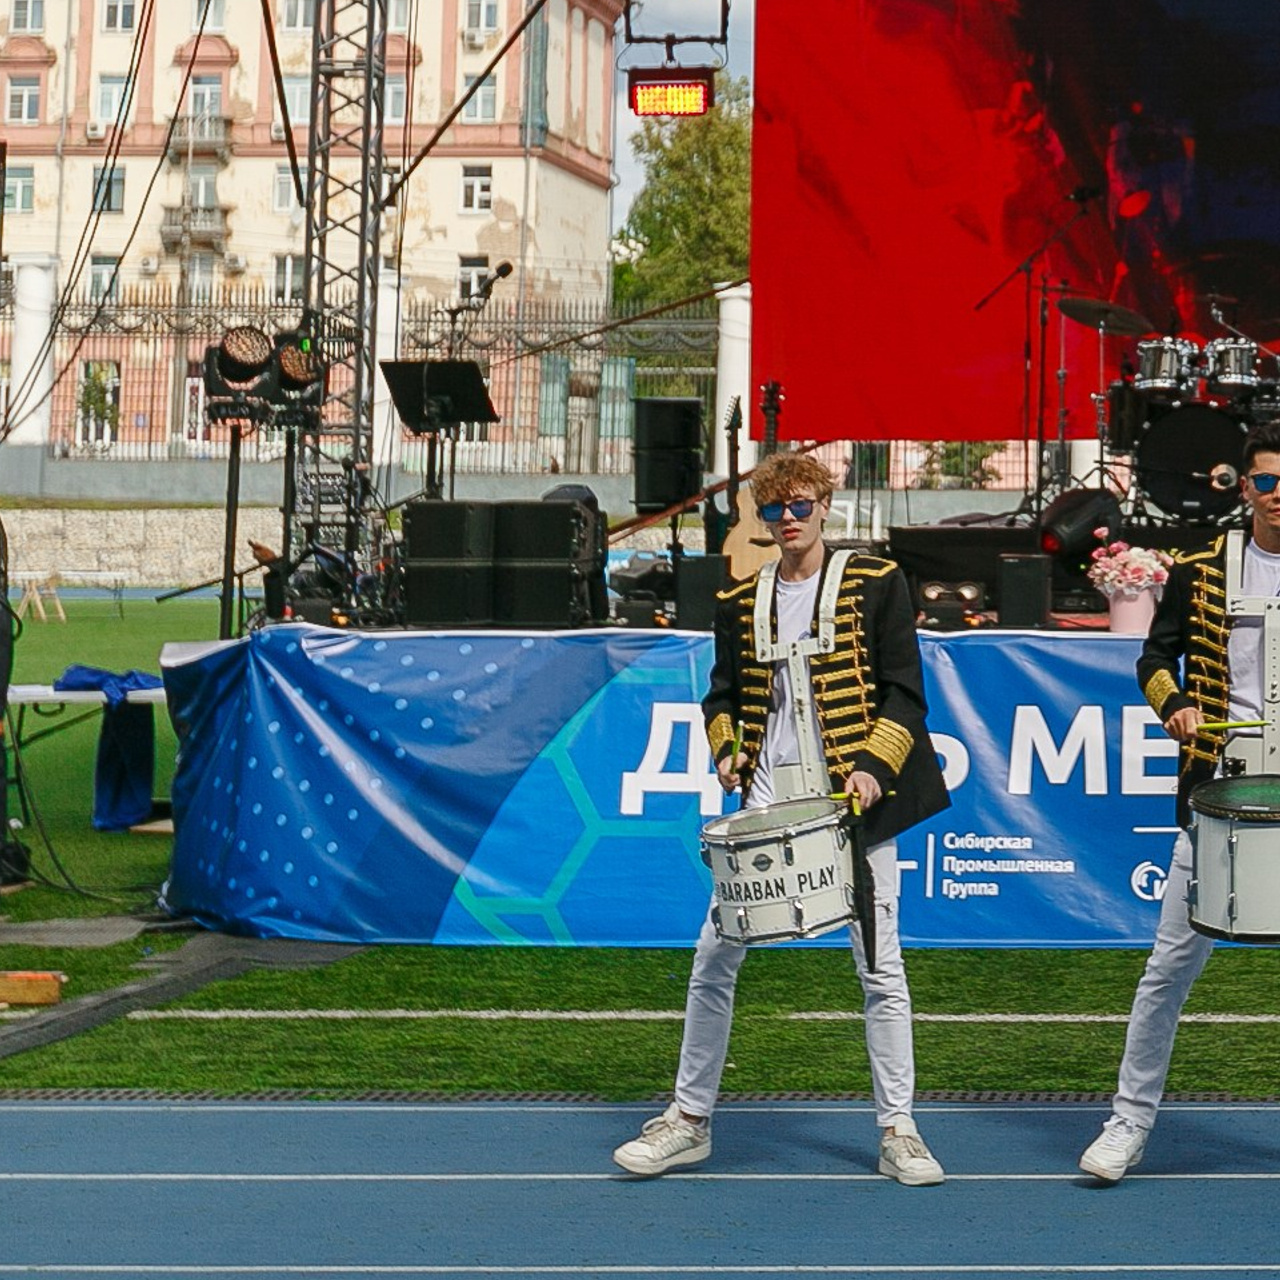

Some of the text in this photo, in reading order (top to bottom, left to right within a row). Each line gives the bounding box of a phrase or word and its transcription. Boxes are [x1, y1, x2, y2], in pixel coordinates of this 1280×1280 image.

[942, 832, 1033, 853] Сибирская
[942, 855, 1076, 876] Промышленная
[941, 878, 999, 899] Группа
